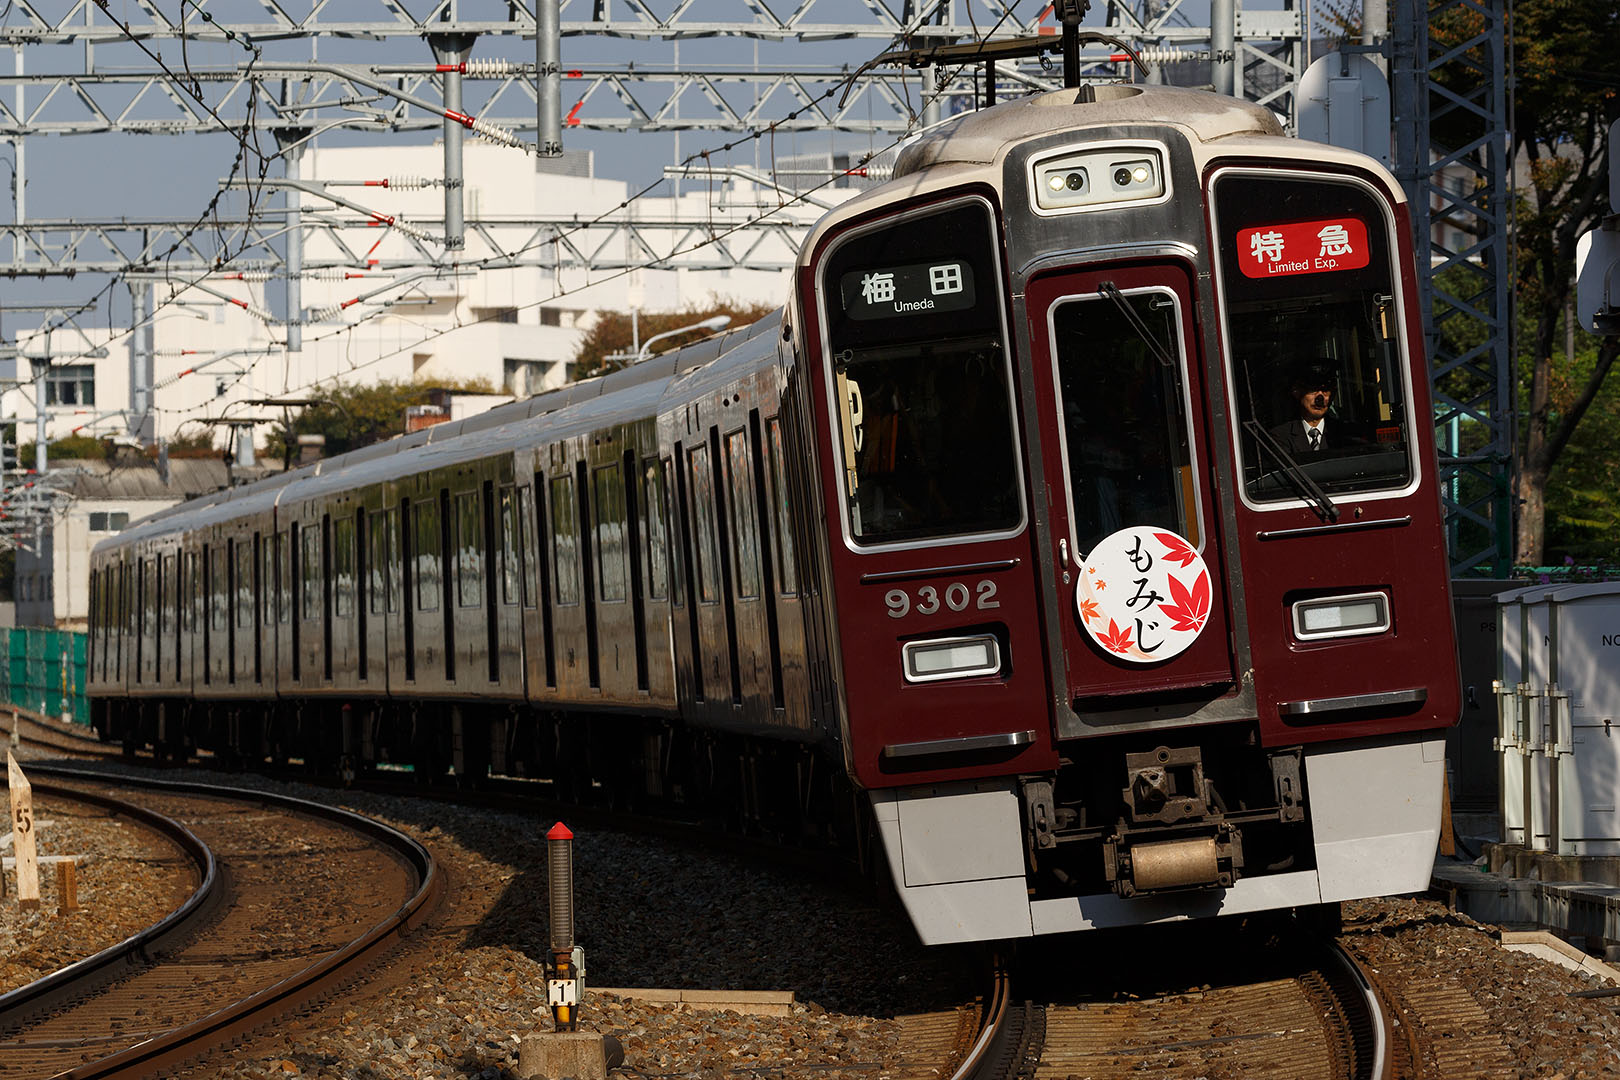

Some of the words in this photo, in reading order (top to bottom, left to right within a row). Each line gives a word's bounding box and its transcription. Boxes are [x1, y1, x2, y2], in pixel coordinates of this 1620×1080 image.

[1250, 224, 1353, 264] 特急
[1268, 259, 1309, 274] Limited
[1314, 257, 1340, 270] Exp.
[861, 263, 963, 305] 梅田
[893, 298, 935, 313] Umeda
[884, 579, 1001, 619] 9302
[1124, 535, 1165, 654] もみじ
[16, 808, 31, 834] 5
[557, 983, 566, 1003] 1
